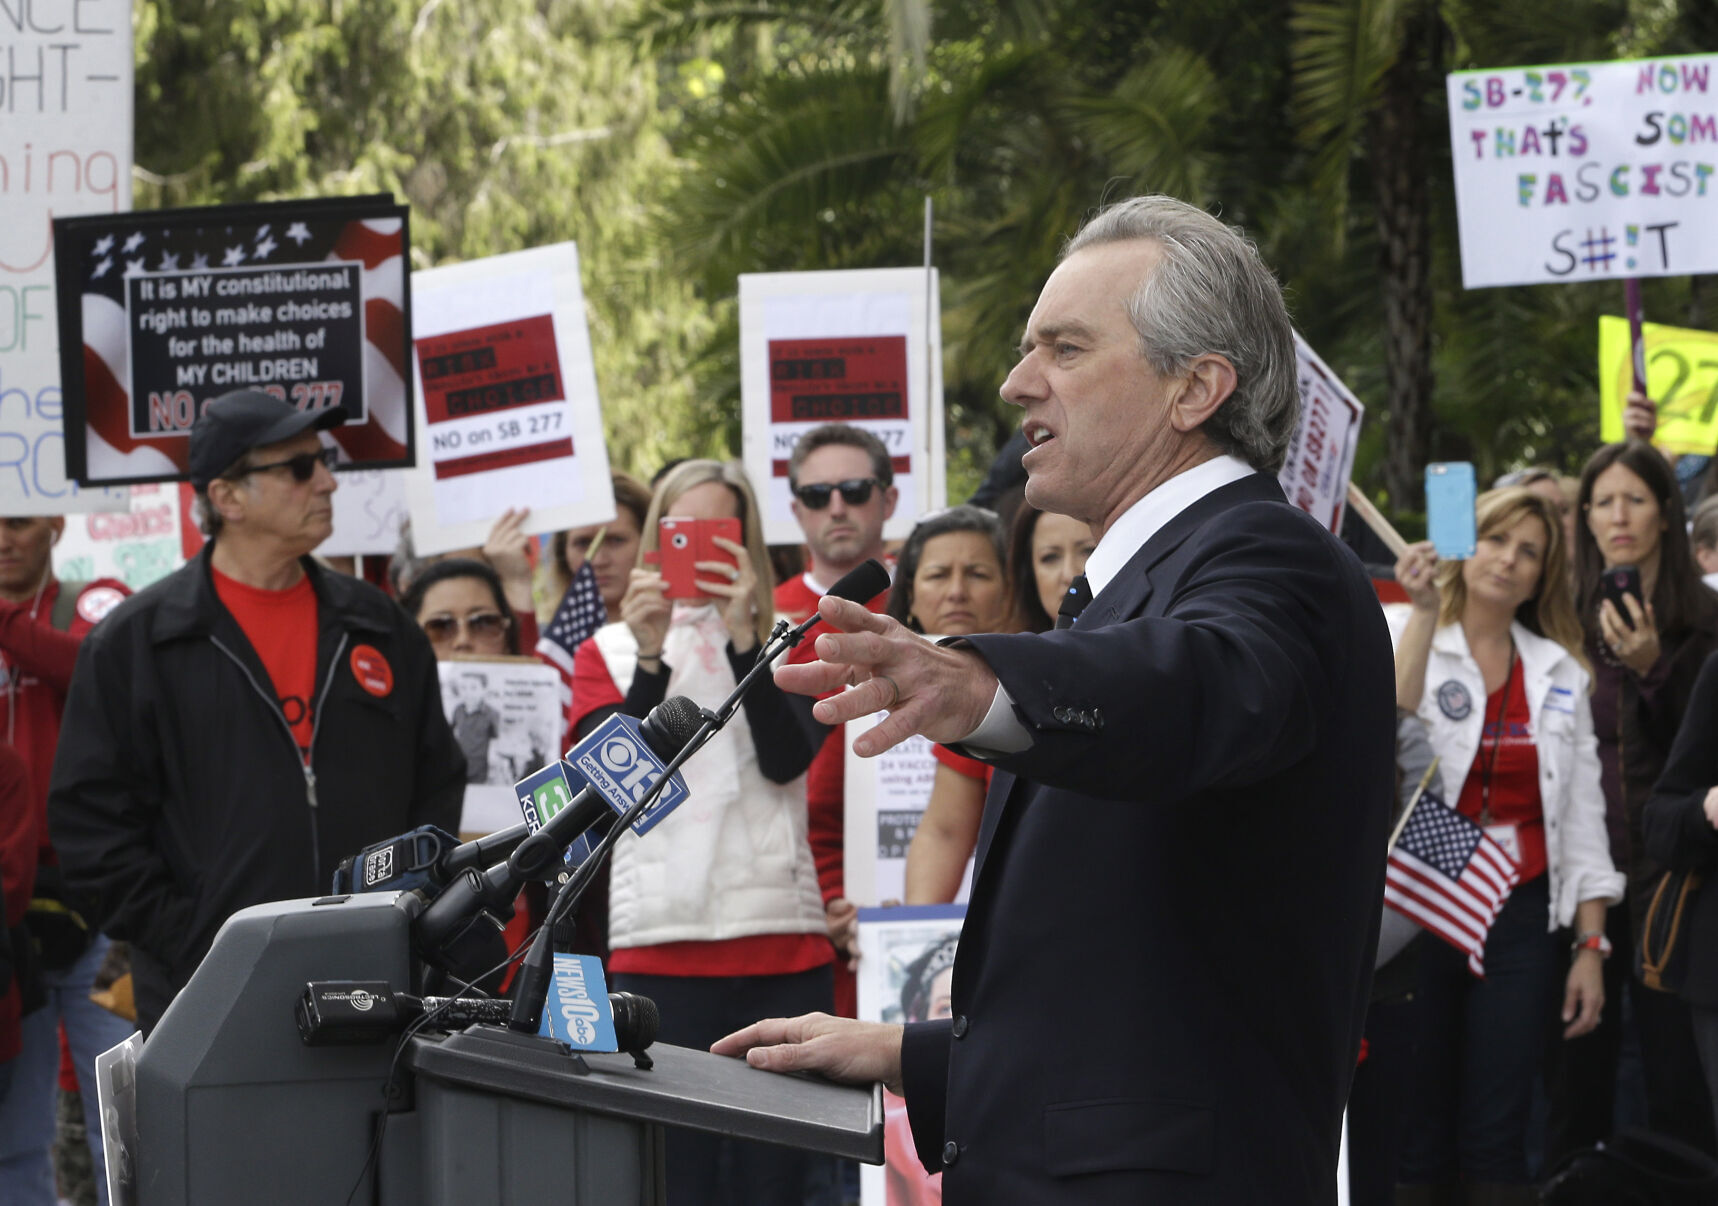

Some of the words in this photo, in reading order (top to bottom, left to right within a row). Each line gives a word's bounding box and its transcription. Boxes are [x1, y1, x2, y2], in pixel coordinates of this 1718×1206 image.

[1636, 63, 1710, 95] NOW
[1518, 161, 1714, 207] FASCIST
[1545, 220, 1680, 276] S#!T
[140, 279, 154, 299] It
[159, 278, 177, 297] is
[182, 275, 213, 296] MY
[216, 268, 350, 296] constitutional
[139, 306, 188, 334] right
[192, 306, 211, 327] to
[216, 301, 273, 325] make
[276, 299, 352, 322] choices
[168, 336, 198, 357] for
[202, 333, 234, 356] the
[238, 329, 301, 353] health
[305, 327, 326, 350] of
[177, 364, 208, 386] MY
[211, 357, 318, 385] CHILDREN
[148, 390, 195, 431] NO
[433, 430, 463, 451] NO
[468, 428, 492, 446] on
[497, 419, 521, 441] SB
[527, 411, 564, 435] 277
[578, 755, 610, 793] Getting
[575, 1018, 588, 1045] abc
